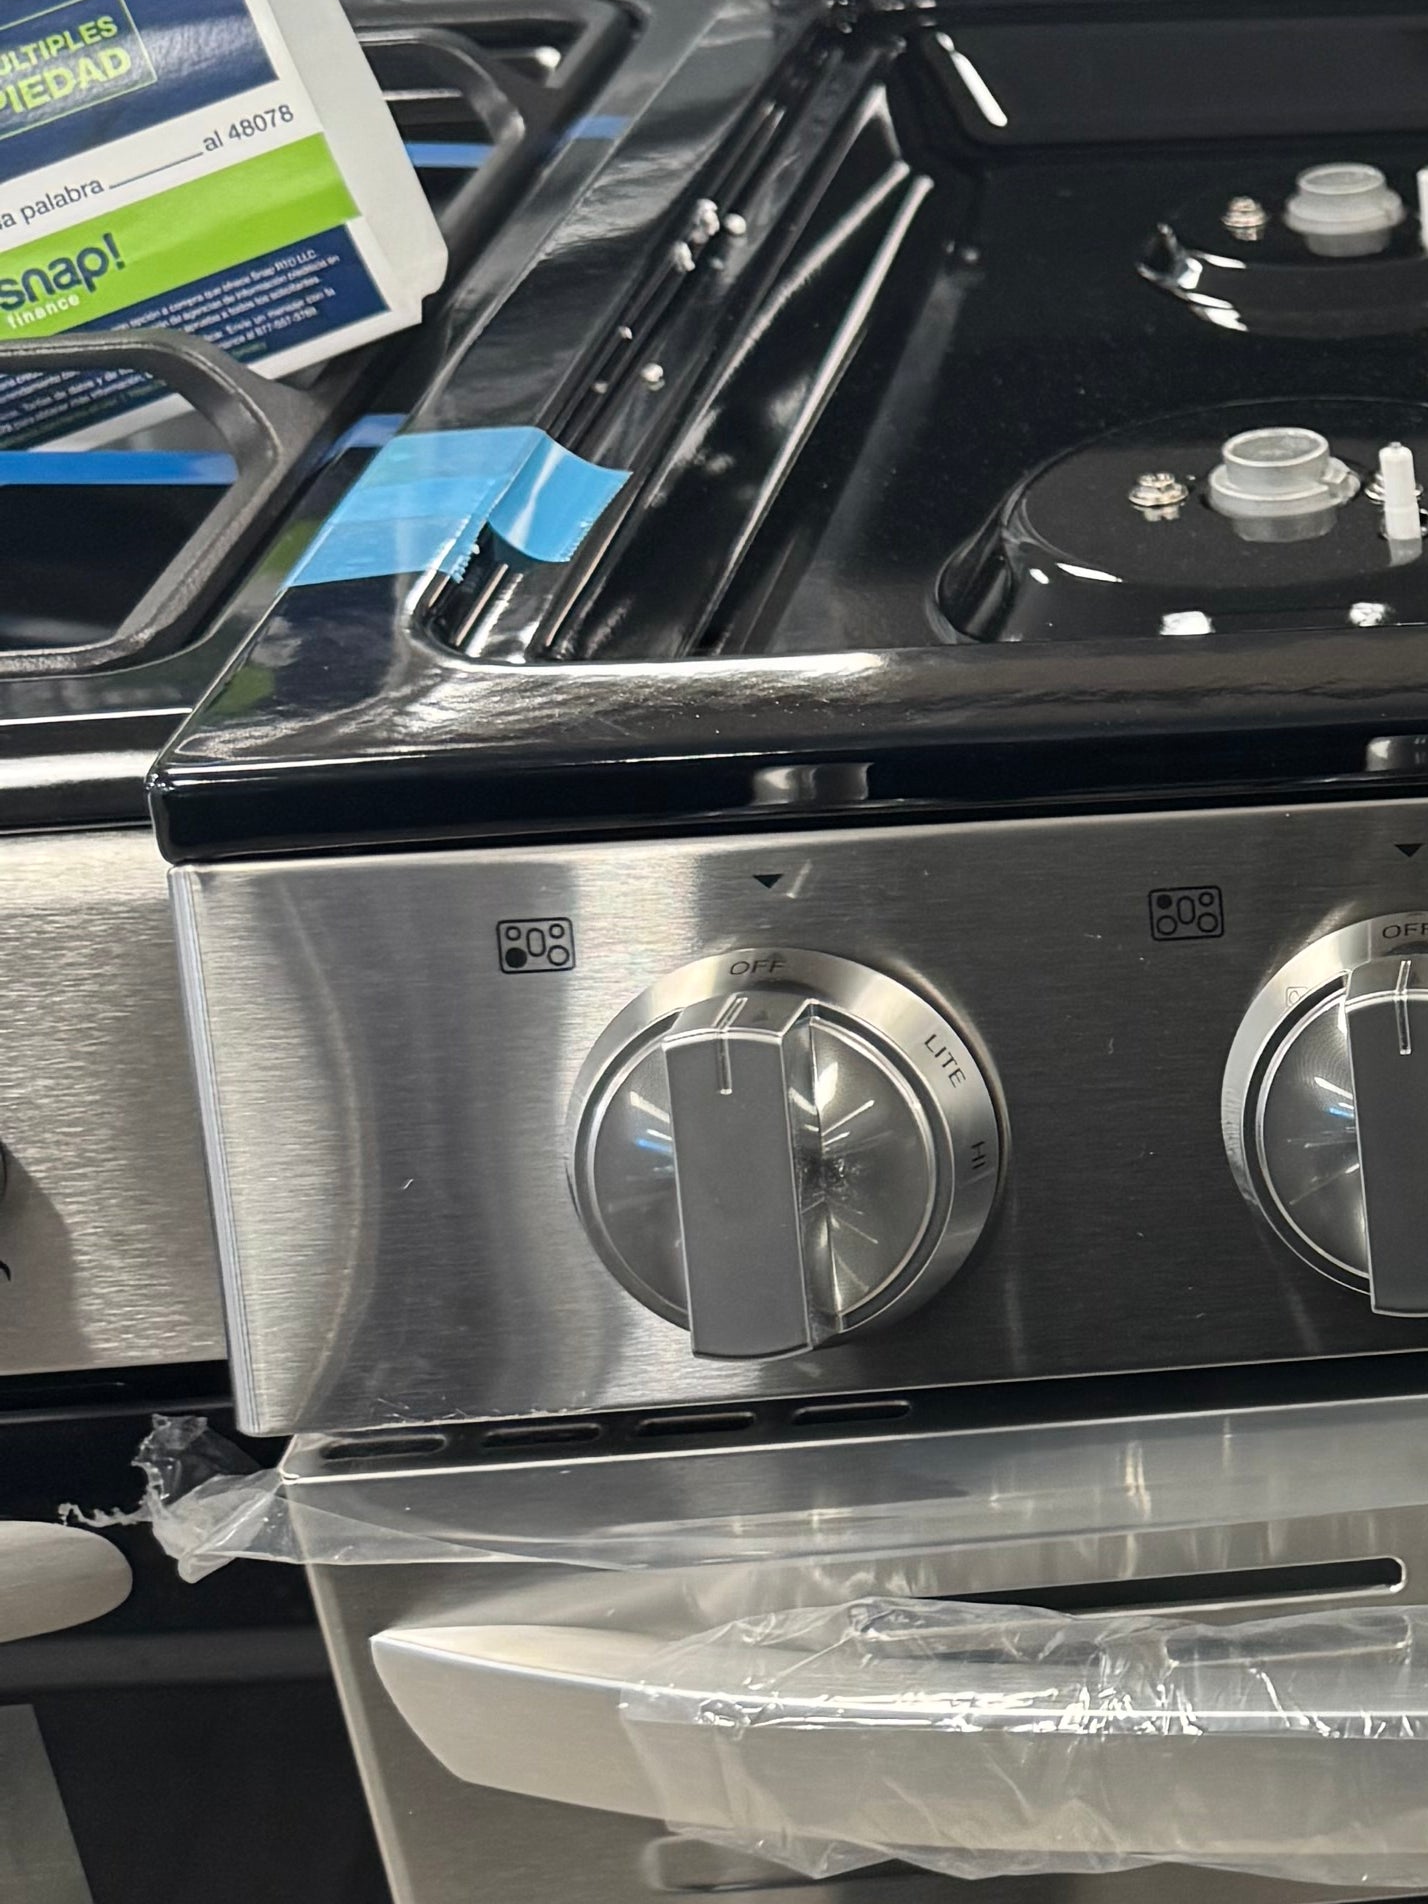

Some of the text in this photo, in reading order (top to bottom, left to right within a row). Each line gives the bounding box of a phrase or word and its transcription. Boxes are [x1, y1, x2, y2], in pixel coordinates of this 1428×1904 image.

[20, 179, 105, 225] palabra
[203, 132, 224, 152] al
[228, 104, 295, 143] 48078
[0, 232, 126, 311] snap!
[7, 294, 81, 329] finance
[729, 958, 787, 977] OFF
[923, 1033, 967, 1090] LITE
[970, 1139, 988, 1171] HI
